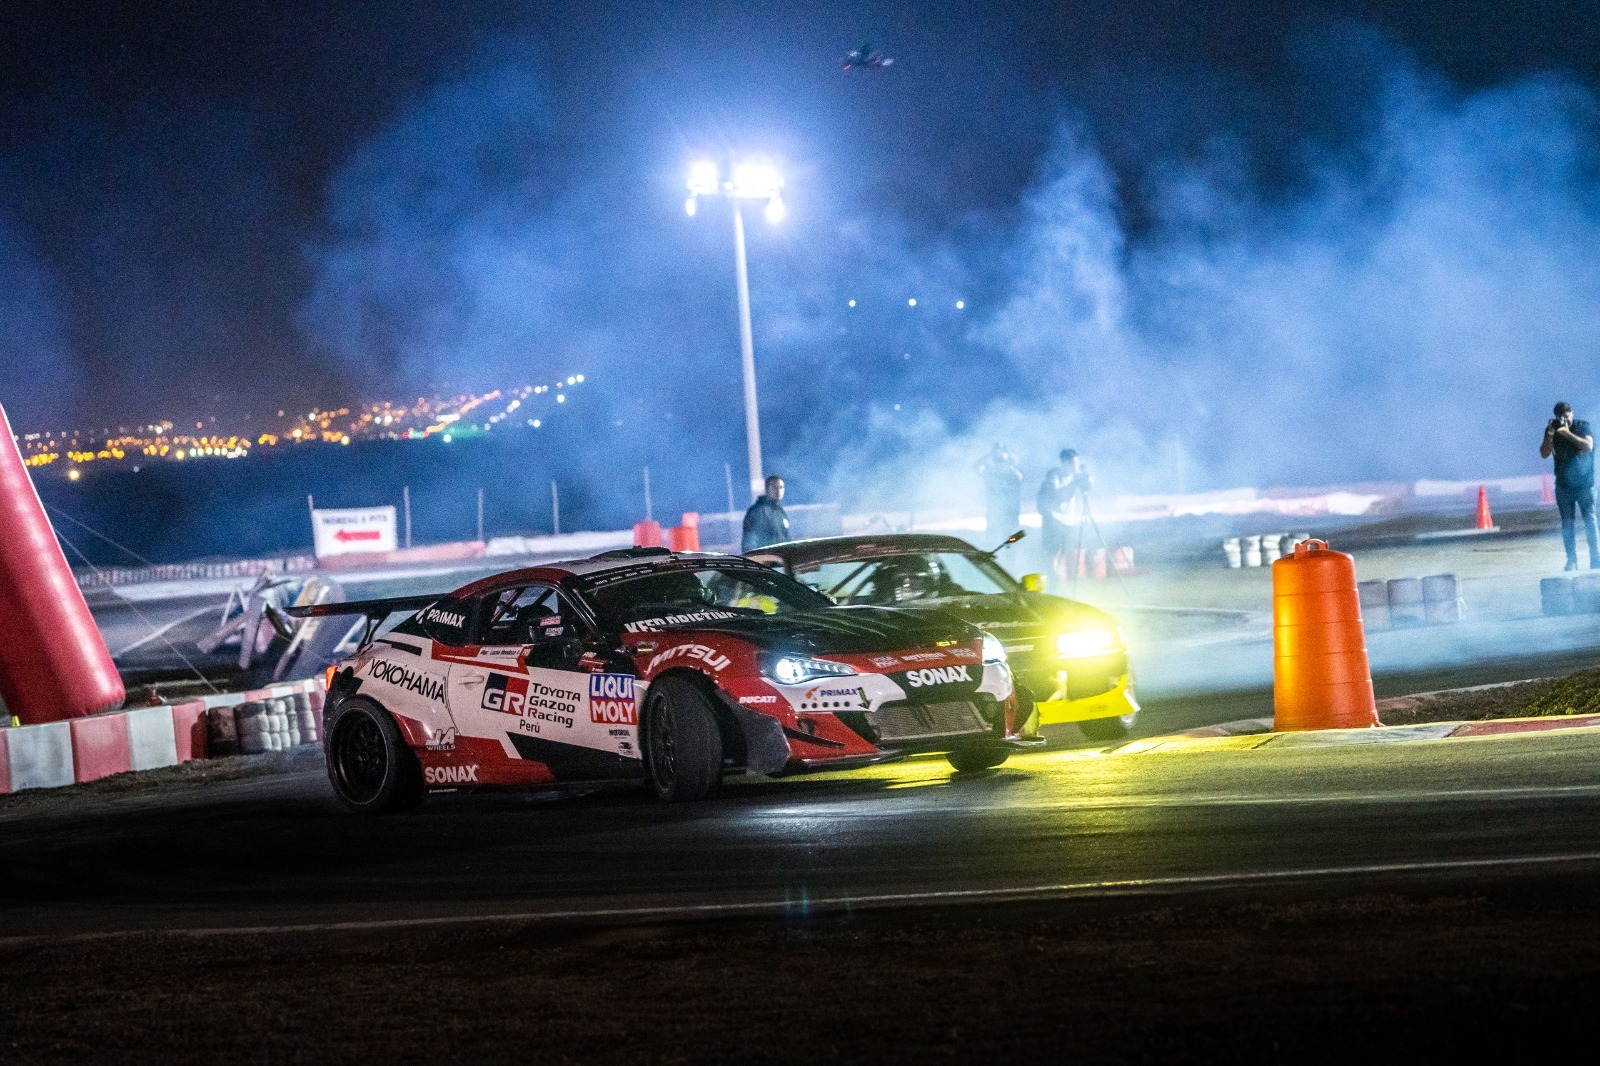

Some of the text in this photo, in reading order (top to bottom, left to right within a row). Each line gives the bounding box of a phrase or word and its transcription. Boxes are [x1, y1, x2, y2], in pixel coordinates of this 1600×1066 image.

[427, 608, 466, 628] PRIMAX
[646, 644, 731, 675] MITSUI
[368, 659, 445, 703] YOKOHAMA
[906, 665, 973, 688] SONAX
[532, 682, 581, 702] TOYOTA
[591, 676, 634, 699] LIQUI
[820, 688, 858, 697] PRIMAX
[484, 688, 525, 715] GR
[529, 695, 576, 713] GAZOO
[739, 695, 777, 704] DUCATI
[527, 707, 574, 728] Racing
[591, 701, 635, 723] MOLY
[519, 719, 540, 733] Perú
[424, 765, 478, 783] SONAX
